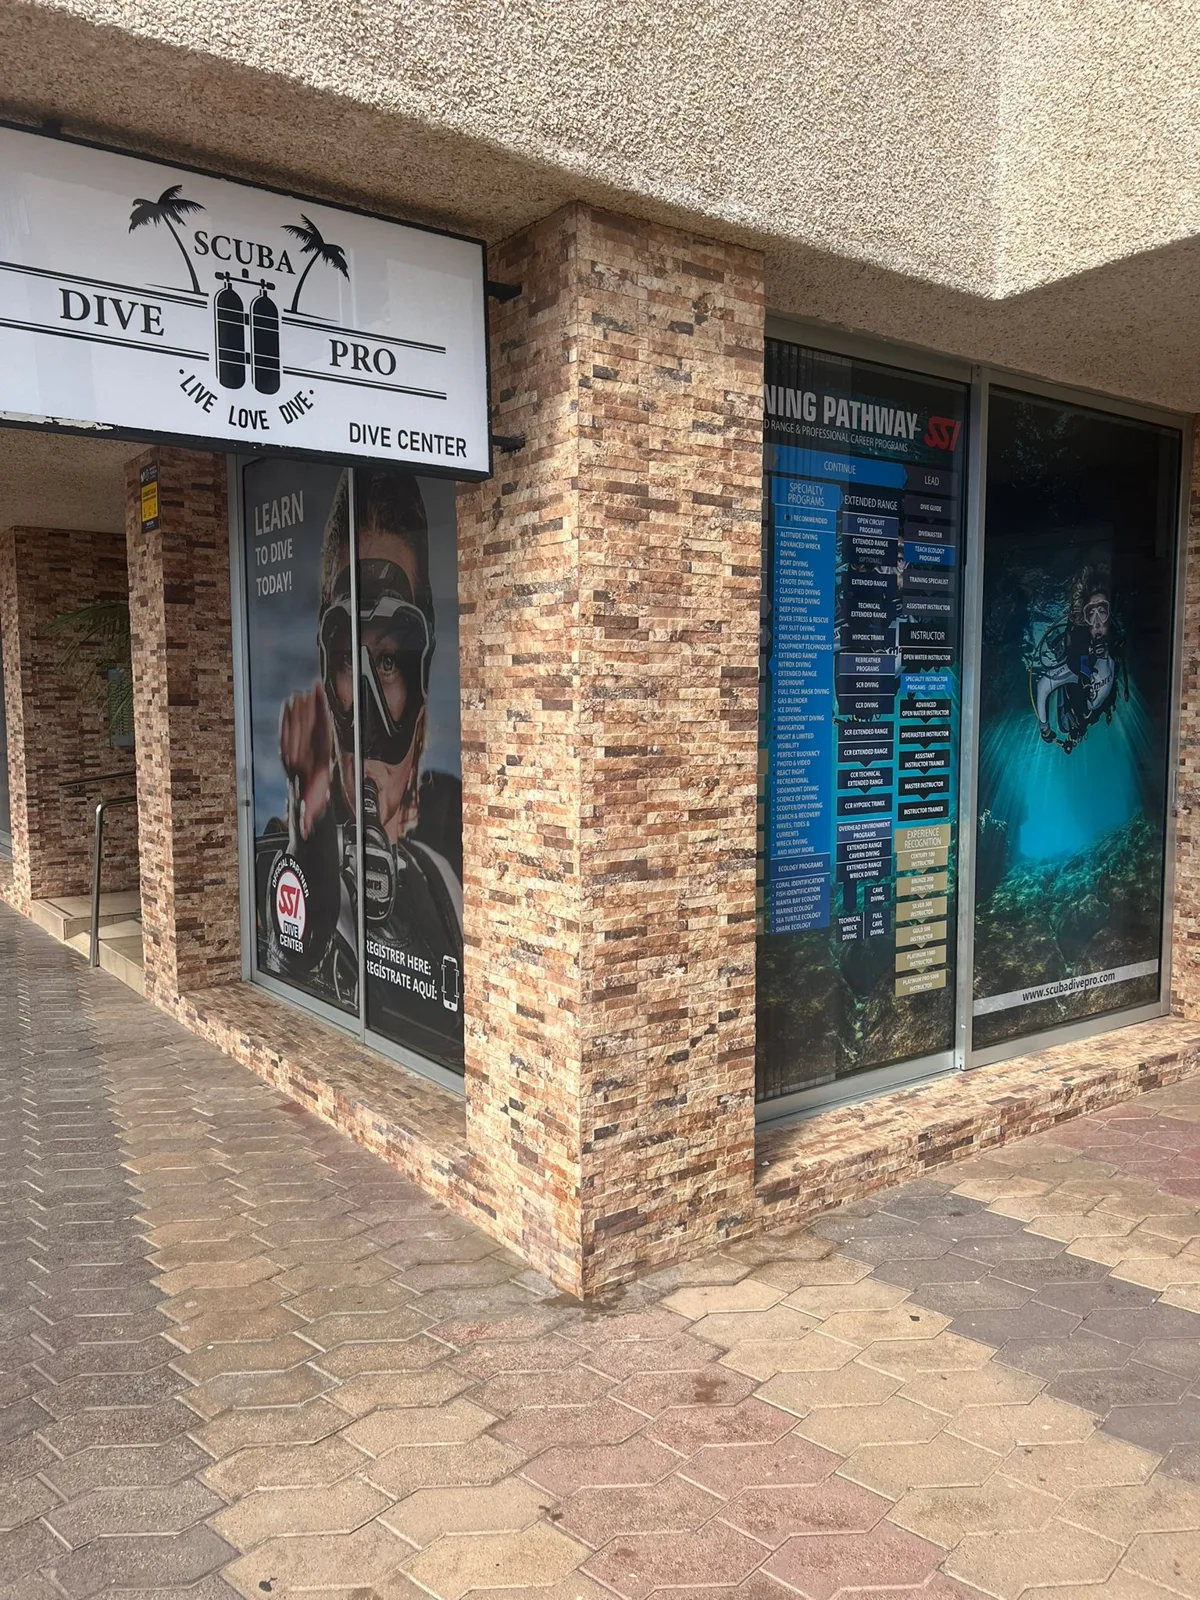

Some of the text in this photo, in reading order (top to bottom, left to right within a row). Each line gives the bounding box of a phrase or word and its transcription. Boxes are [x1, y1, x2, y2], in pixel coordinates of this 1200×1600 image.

[194, 231, 296, 275] SCUBA
[59, 288, 164, 336] DIVE
[329, 339, 396, 375] PRO
[180, 375, 314, 429] LIVE LOVE DIVE
[824, 396, 918, 439] PATHWAY
[350, 422, 466, 458] DIVE CENTER
[771, 420, 794, 433] RANGE
[796, 425, 800, 434] &
[802, 426, 849, 442] PROFESSIONAL
[851, 434, 874, 446] CAREER
[875, 439, 908, 452] PROGRAMS
[924, 416, 961, 451] SSI
[824, 461, 856, 474] CONTINUE
[790, 482, 823, 495] SPECIALTY
[925, 476, 939, 486] LEAD
[788, 493, 824, 506] PROGRAMS
[845, 495, 898, 511] EXTENDED RANGE
[255, 490, 304, 536] LEARN
[853, 538, 873, 546] EXTENDED
[919, 530, 942, 538] DIVEMASTER
[255, 538, 293, 566] TO DIVE
[256, 571, 292, 596] TODAY!
[928, 577, 948, 585] SPECIALIST
[911, 631, 945, 640] INSTRUCTOR
[904, 837, 942, 848] RECOGNITION
[907, 828, 940, 839] EXPERIENCE
[779, 861, 823, 872] ECOLOGY PROGRAMS
[272, 858, 309, 897] OFFICIAL PARTNER
[279, 884, 300, 918] SSI
[284, 922, 298, 938] DIVE
[280, 934, 303, 953] CENTER
[408, 954, 431, 975] HERE:
[413, 978, 437, 1000] AQUÍ:
[1022, 972, 1115, 1001] www.scubadivepro.com
